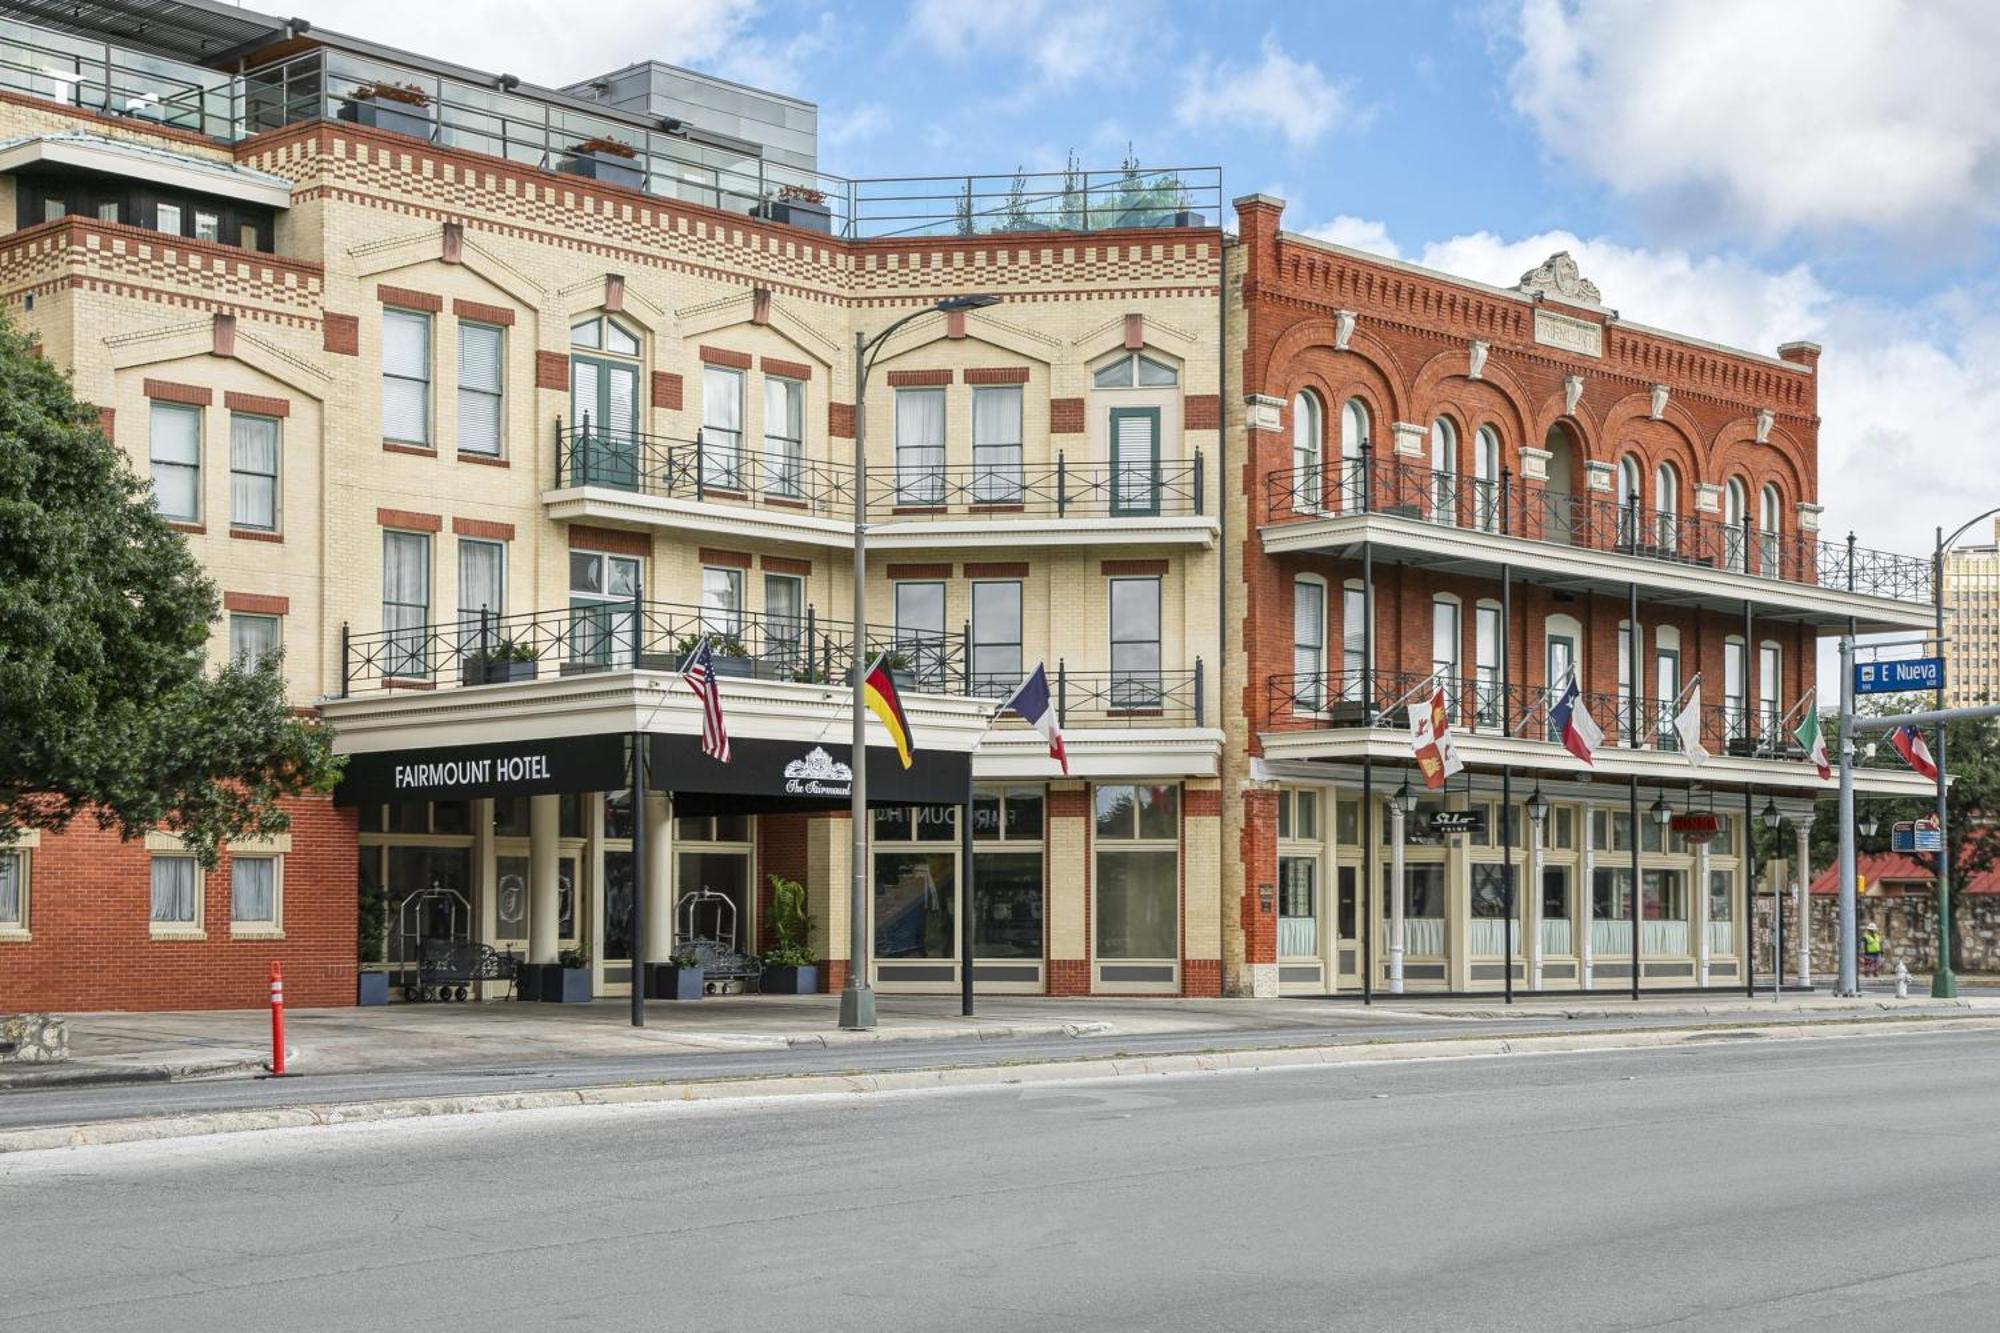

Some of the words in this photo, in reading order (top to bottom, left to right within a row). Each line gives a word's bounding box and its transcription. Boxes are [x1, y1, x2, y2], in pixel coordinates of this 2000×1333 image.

[1882, 664, 1889, 682] E
[1896, 663, 1936, 681] Nueva
[395, 759, 492, 788] FAIRMOUNT
[497, 755, 551, 782] HOTEL
[786, 779, 804, 793] The
[805, 780, 852, 796] Fairmount
